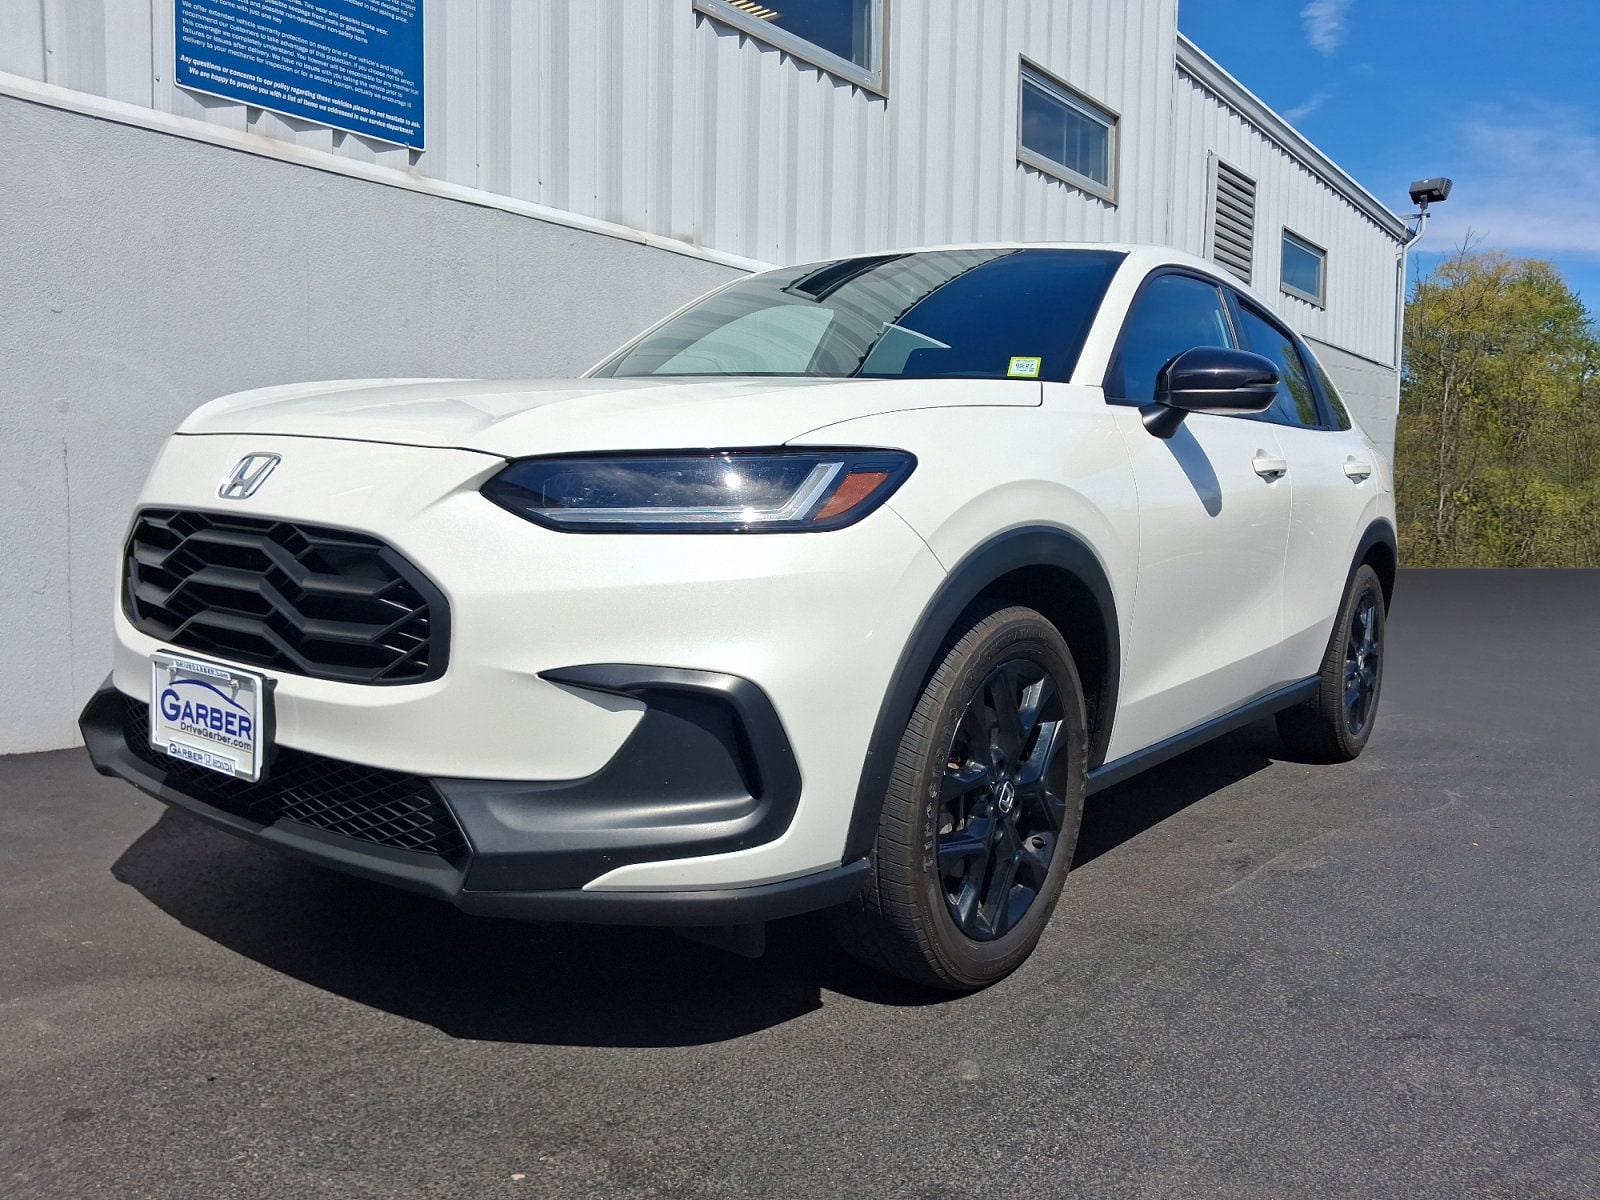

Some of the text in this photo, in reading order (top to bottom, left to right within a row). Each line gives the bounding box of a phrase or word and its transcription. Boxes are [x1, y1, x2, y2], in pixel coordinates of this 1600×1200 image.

[193, 5, 207, 13] offer
[208, 10, 235, 22] extended
[236, 19, 256, 28] vehicle
[257, 25, 280, 38] warranty
[282, 33, 308, 45] protection
[317, 45, 331, 54] every
[249, 8, 260, 16] just
[262, 5, 284, 16] possible
[339, 15, 360, 25] possible
[182, 11, 218, 25] recommend
[230, 25, 260, 38] customers
[267, 36, 279, 44] take
[280, 41, 308, 54] advantage
[316, 51, 325, 59] this
[368, 68, 385, 77] choose
[182, 18, 194, 26] this
[195, 23, 221, 35] coverage
[232, 34, 262, 48] completely
[263, 44, 295, 57] understand.
[308, 57, 329, 67] however
[347, 70, 375, 81] responsible
[182, 27, 204, 38] failures
[213, 36, 232, 46] issues
[248, 46, 270, 59] delivery.
[281, 57, 295, 65] have
[304, 63, 320, 73] issues
[343, 75, 359, 85] taking
[368, 84, 385, 92] vehicle
[182, 35, 205, 48] delivery
[228, 50, 255, 61] mechanic
[265, 60, 293, 73] inspection
[314, 76, 332, 84] second
[354, 88, 373, 98] actually
[193, 59, 221, 71] questions
[229, 70, 255, 81] concerns
[273, 82, 290, 93] policy
[291, 87, 316, 100] regarding
[332, 99, 352, 109] vehicles
[352, 104, 369, 114] please
[386, 113, 404, 124] hesitate
[211, 73, 229, 85] happy
[236, 82, 258, 92] provide
[287, 94, 296, 102] list
[304, 99, 318, 108] items
[328, 107, 353, 118] addressed
[368, 119, 386, 127] service
[386, 122, 414, 135] department.
[161, 688, 252, 740] GARBER
[180, 721, 251, 751] DriveGarber.com
[169, 743, 204, 762] GARBER
